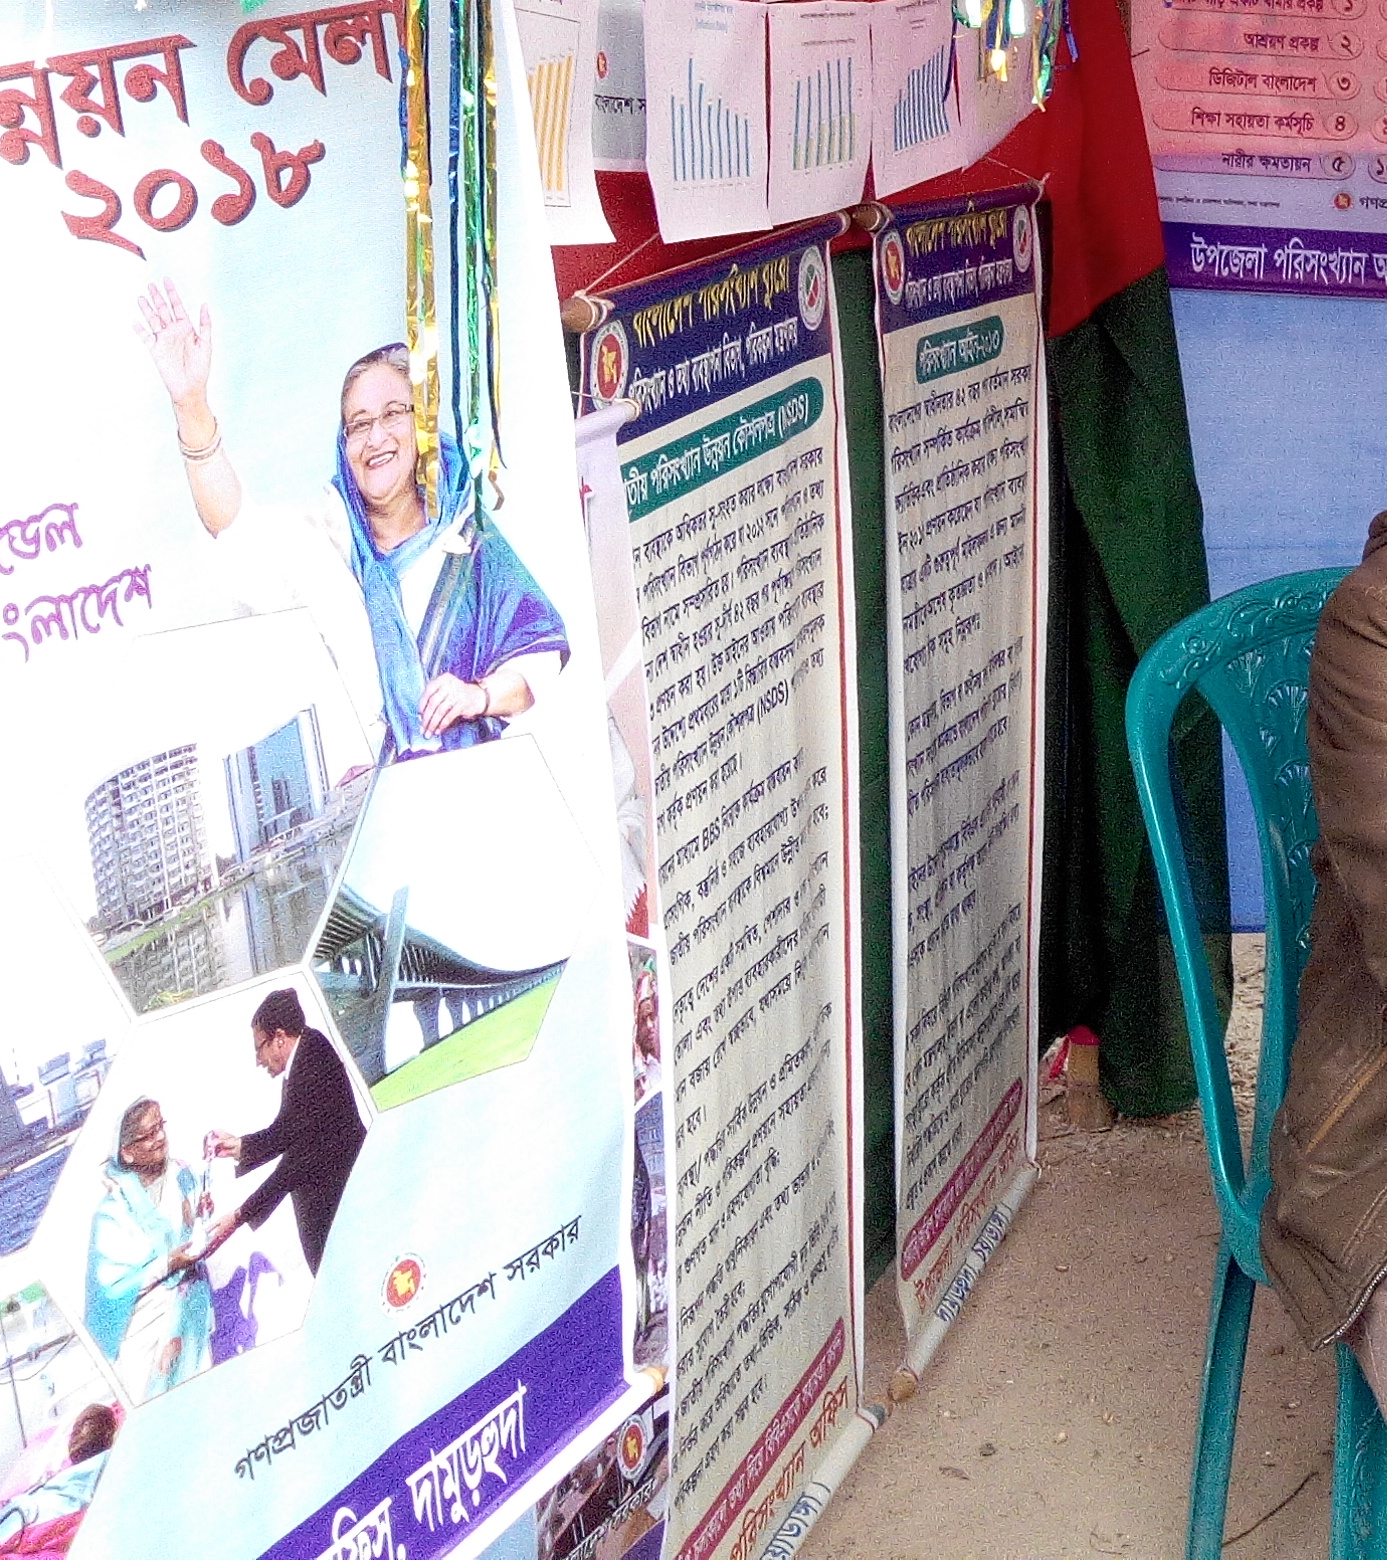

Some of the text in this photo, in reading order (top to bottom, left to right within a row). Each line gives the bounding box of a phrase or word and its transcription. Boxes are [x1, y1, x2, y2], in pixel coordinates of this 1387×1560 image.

[1209, 67, 1257, 89] ডিজিটাল
[1262, 73, 1317, 92] বাংলাদেশ
[1191, 107, 1346, 135] শিক্ষা সহায়তা কর্মসূচি ৪
[1222, 148, 1253, 168] নারীর
[1259, 155, 1312, 172] ক্ষমতায়ন
[61, 132, 327, 261] ২০১৮
[1190, 231, 1268, 281] উপজেলা
[1273, 236, 1369, 284] পরিসংখ্যান
[701, 431, 732, 474] উন্নয়ন
[756, 678, 788, 724] (NSDS)
[702, 817, 720, 851] BBS
[377, 1272, 498, 1367] বাংলাদেশ
[502, 1214, 582, 1281] সরকার
